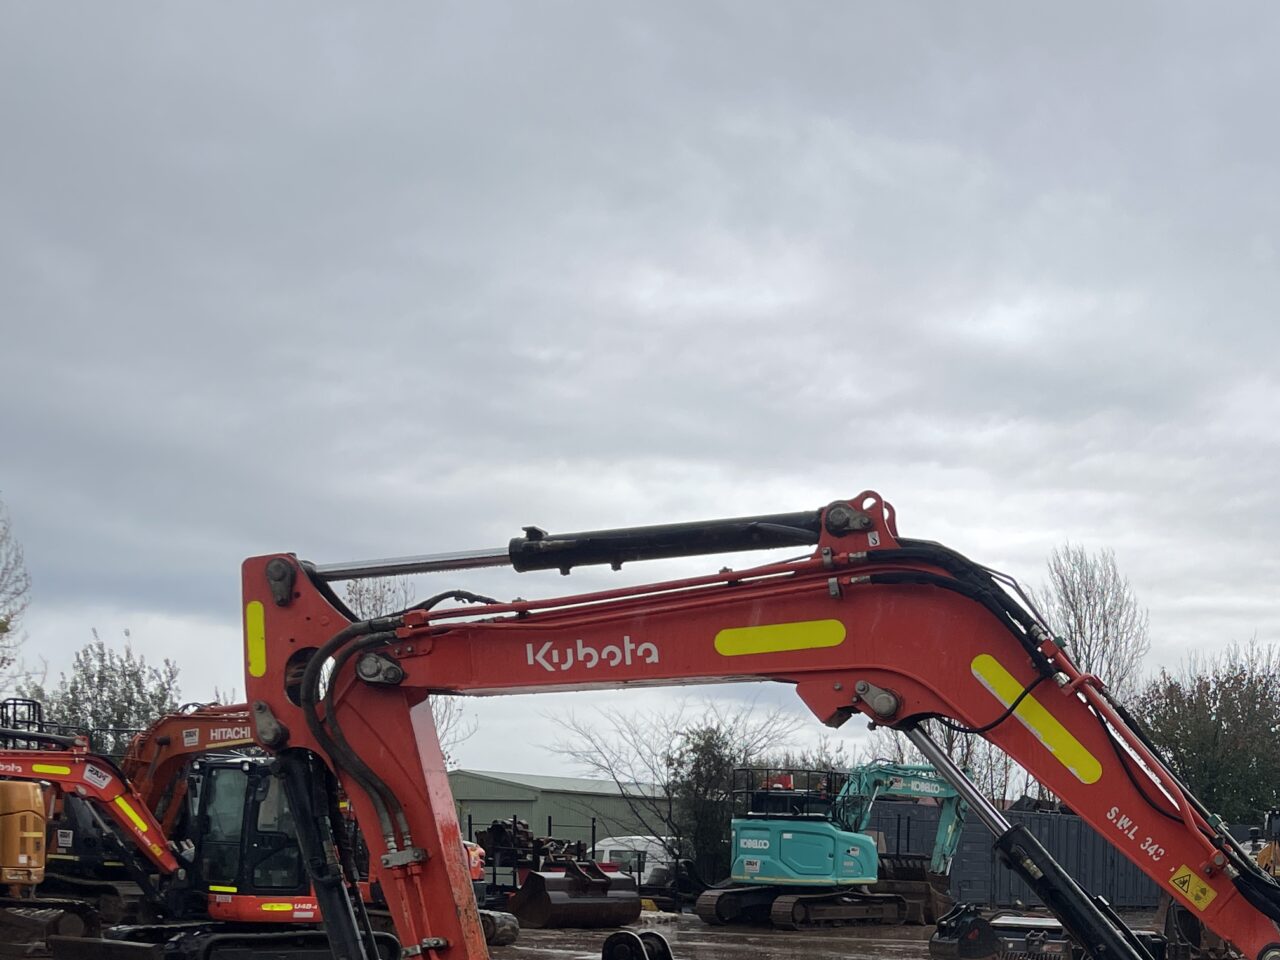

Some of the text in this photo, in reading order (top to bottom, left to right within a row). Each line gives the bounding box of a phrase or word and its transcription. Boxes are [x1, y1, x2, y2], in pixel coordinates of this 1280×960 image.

[526, 635, 659, 672] Kubota
[210, 726, 251, 740] HITACHI
[740, 839, 770, 850] KOBELCO
